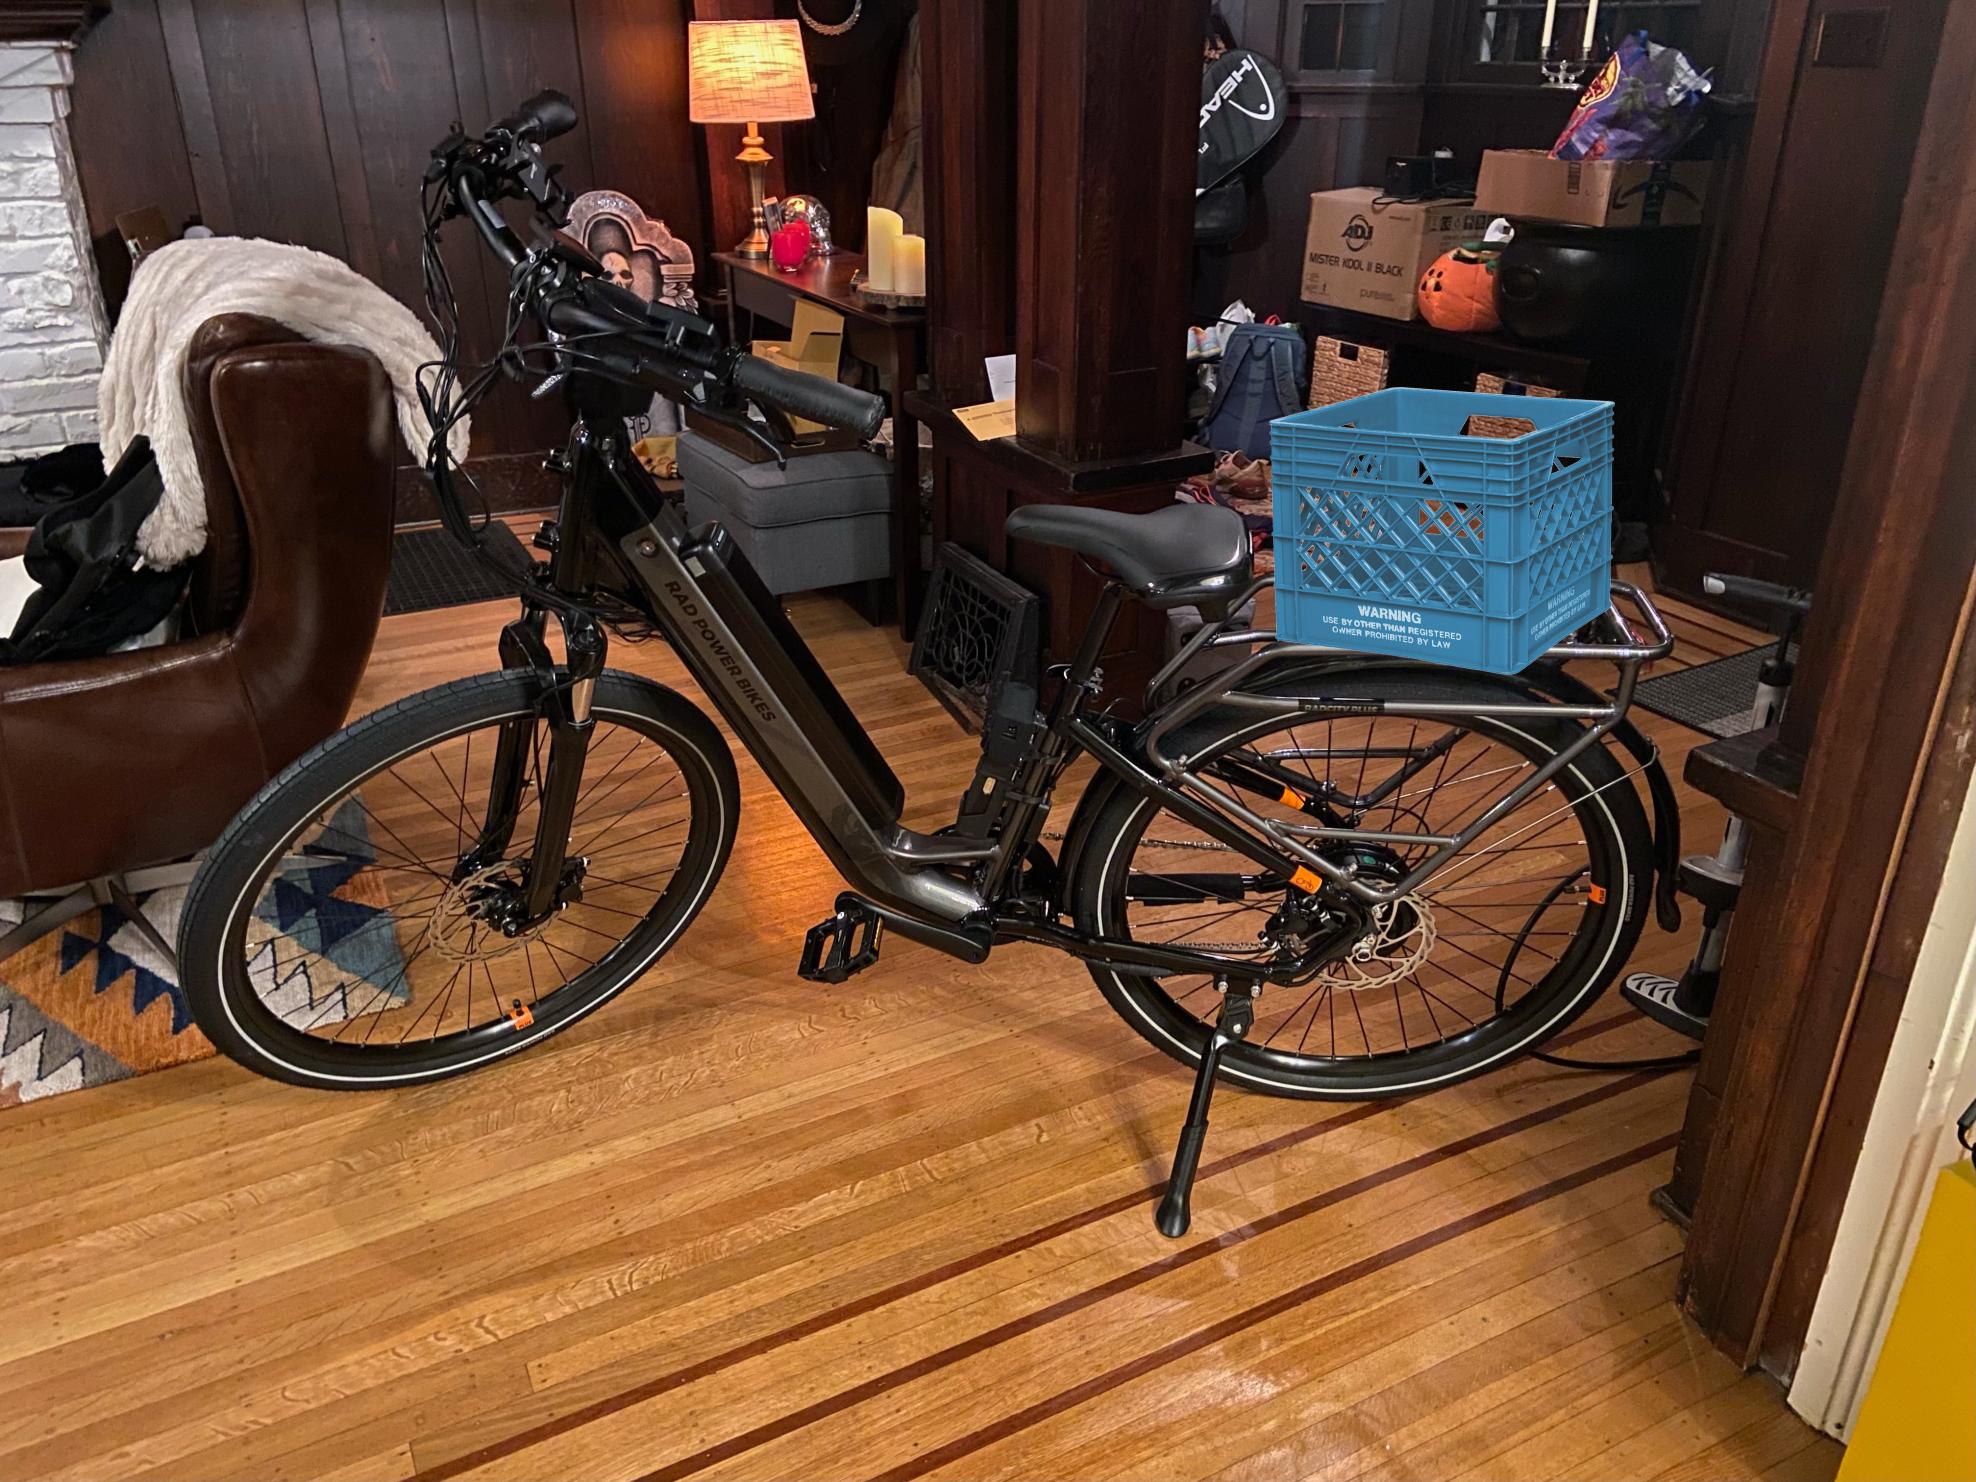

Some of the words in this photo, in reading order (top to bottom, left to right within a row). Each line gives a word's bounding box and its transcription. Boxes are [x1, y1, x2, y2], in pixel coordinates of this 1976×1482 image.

[1310, 252, 1339, 266] MISTER
[1342, 257, 1364, 272] KOOL
[1366, 261, 1373, 273] II
[1375, 263, 1404, 277] BLACK
[1547, 586, 1575, 610] WARNING
[1358, 605, 1422, 624] WARNING
[1322, 616, 1339, 625] USE
[1341, 618, 1352, 626] BY
[1353, 620, 1381, 629] OTHER
[1383, 623, 1406, 633] THAN
[1408, 627, 1462, 641] REGISTERED
[1332, 626, 1362, 637] OWNER
[1364, 631, 1413, 644] PROHIBITED
[1417, 638, 1429, 647] BY
[1431, 640, 1451, 649] LAW
[664, 580, 698, 617] RAD
[692, 618, 742, 677] POWER
[736, 678, 776, 722] BIKES
[1351, 705, 1378, 713] PLUS
